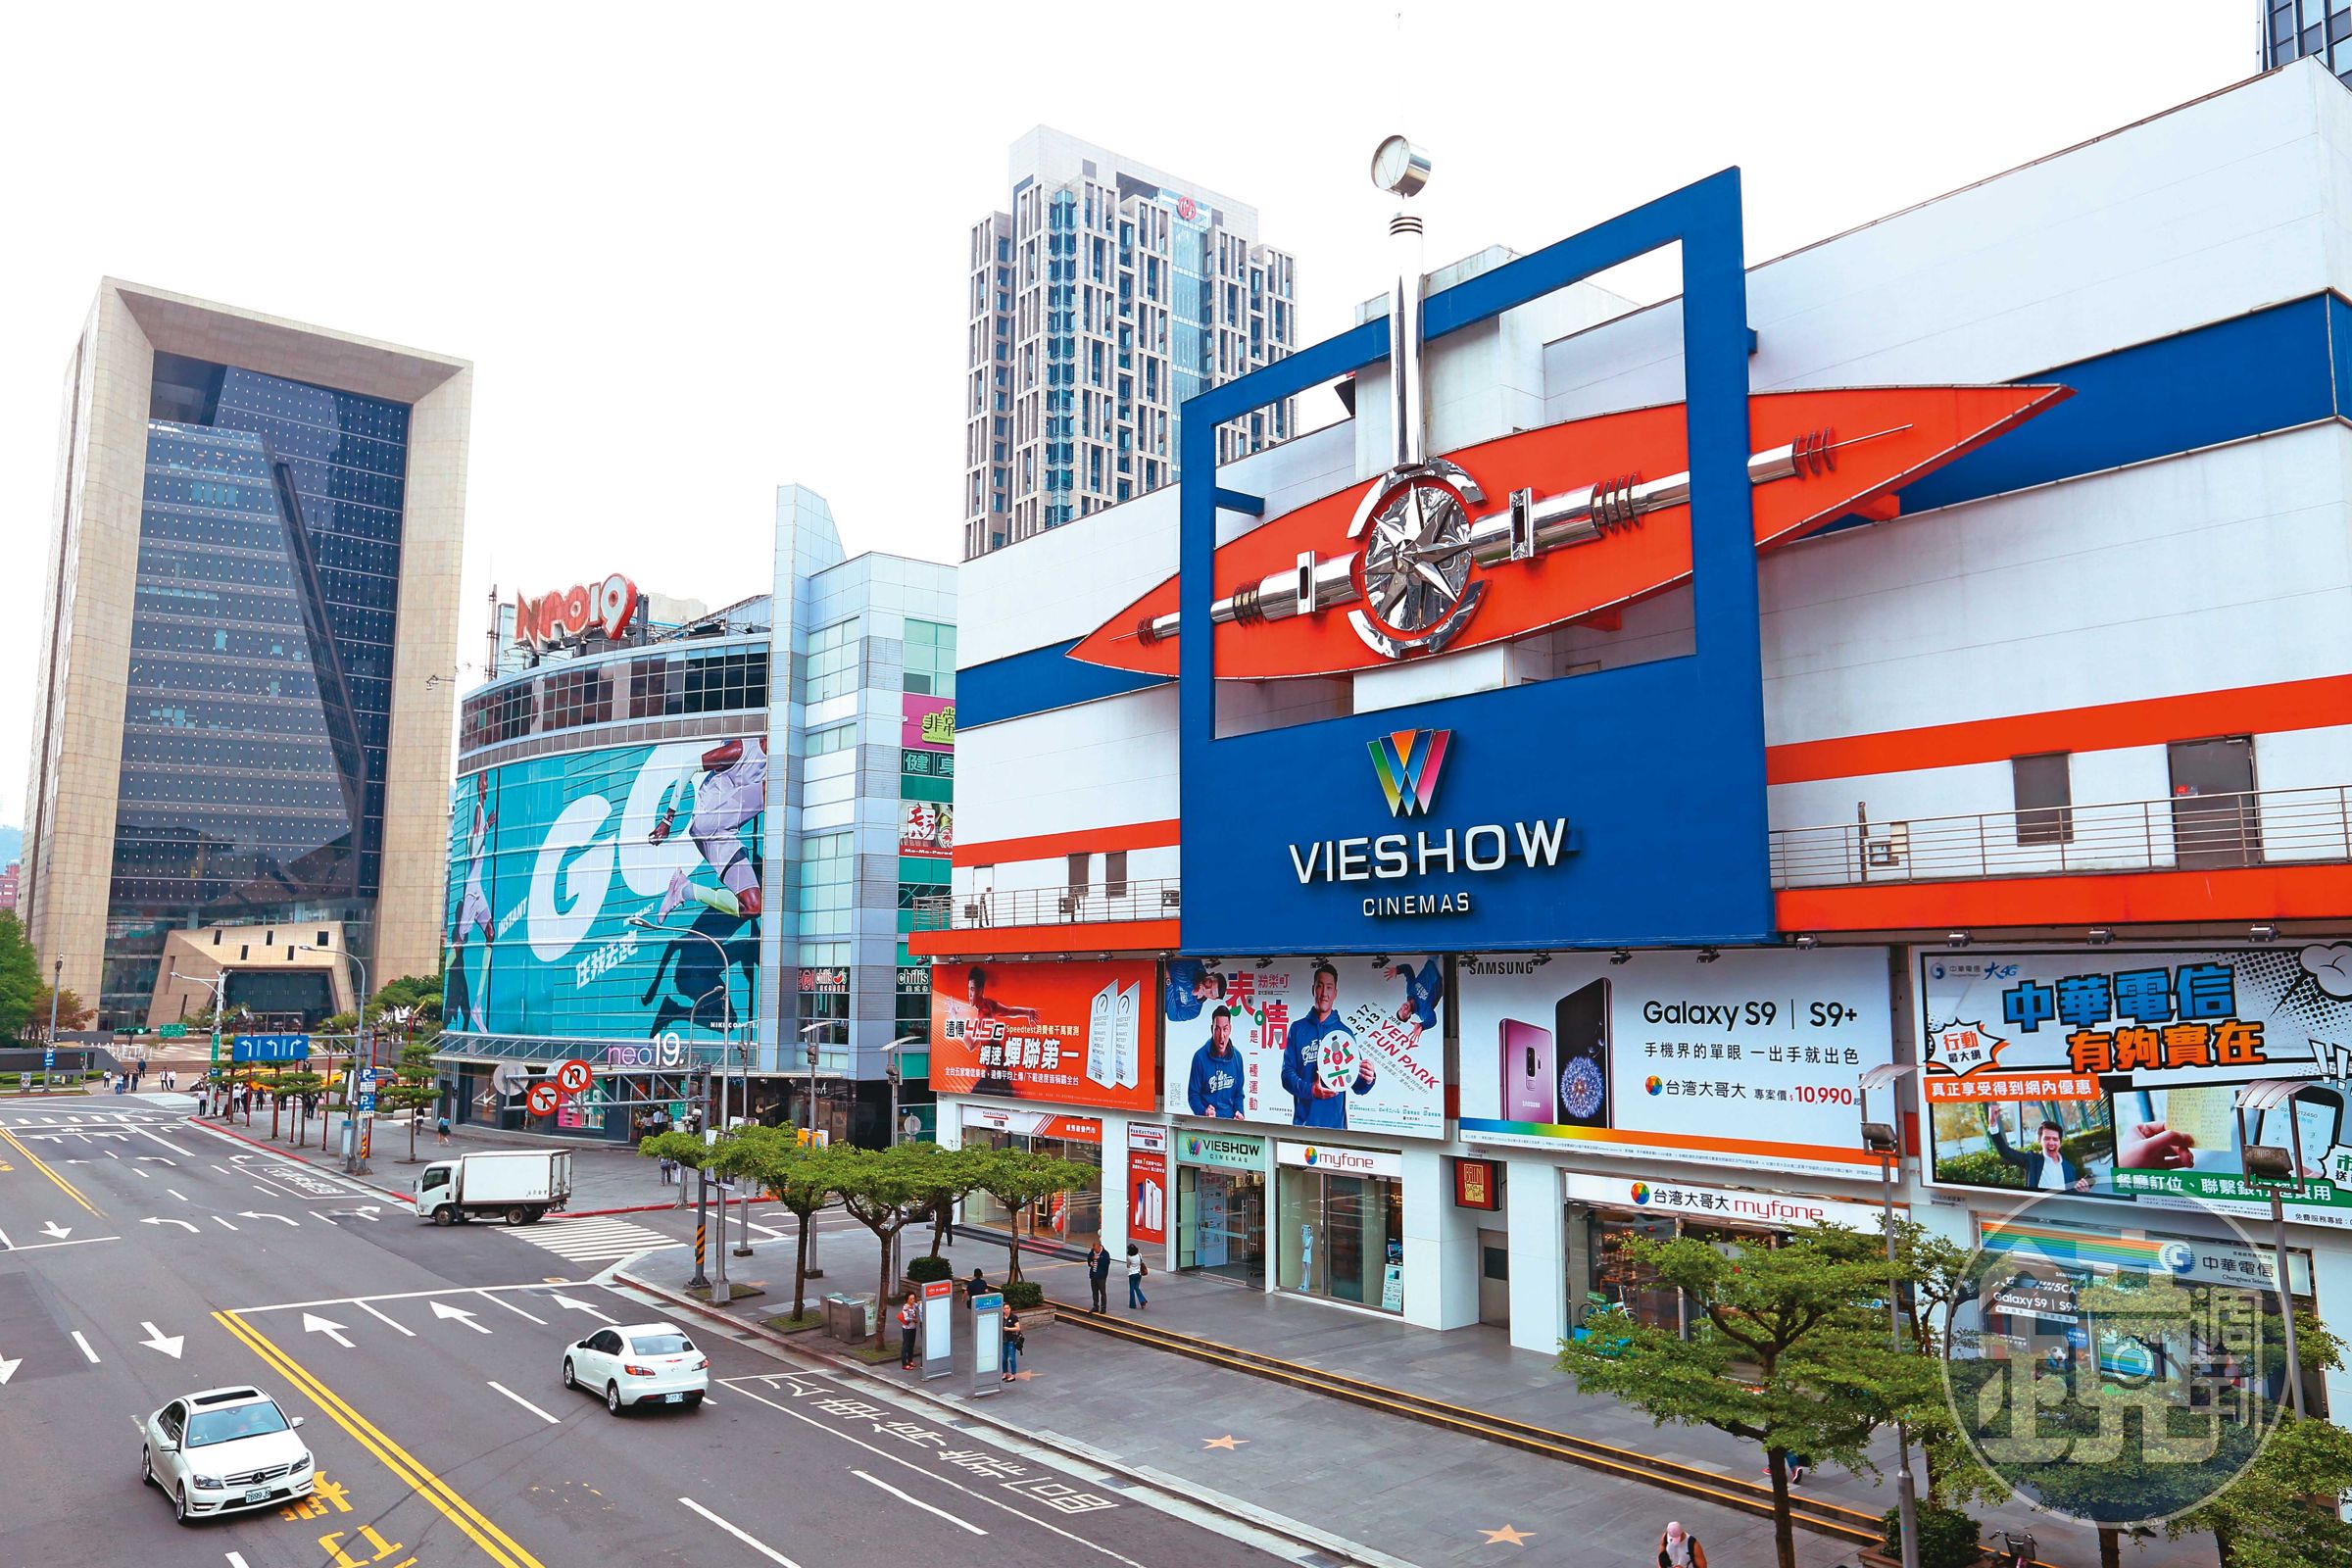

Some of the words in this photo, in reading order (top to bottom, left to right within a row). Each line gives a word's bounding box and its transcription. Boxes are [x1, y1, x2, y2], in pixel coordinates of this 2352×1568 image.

[1289, 817, 1566, 884] VIESHOW
[1362, 892, 1470, 917] CINEMAS
[498, 897, 527, 940] INSTANT
[897, 968, 928, 985] chili's
[1469, 961, 1534, 975] SAMSUNG
[2002, 961, 2237, 1033] 中華電信
[1347, 1004, 1371, 1025] 3.17
[1643, 1000, 1740, 1032] Galaxy
[1744, 1001, 1777, 1026] S9
[1809, 1002, 1857, 1027] S9+
[1381, 1020, 1419, 1051] VERY
[1943, 1031, 1979, 1052] 行動
[2066, 1019, 2267, 1074] 有夠實在
[1004, 1037, 1079, 1070] 蟬聯第一
[1368, 1030, 1399, 1056] FUN
[1397, 1054, 1441, 1090] PARK
[1644, 1042, 1741, 1060] 手機界的單眼
[1750, 1045, 1859, 1065] 一出手就出色
[1948, 1050, 1982, 1063] 最大網
[1754, 1088, 1788, 1102] 專案價
[1932, 1079, 2092, 1097] 真正享受得到網內優惠
[1202, 1139, 1260, 1156] VIESHOW
[1209, 1153, 1248, 1163] CINEMAS
[1319, 1152, 1374, 1169] myfone
[1735, 1200, 1823, 1220] myfone
[2202, 1255, 2274, 1278] 中華電信
[1993, 1292, 2034, 1308] Galaxy
[2034, 1297, 2047, 1308] S9
[760, 1374, 1119, 1514] 公車停靠區
